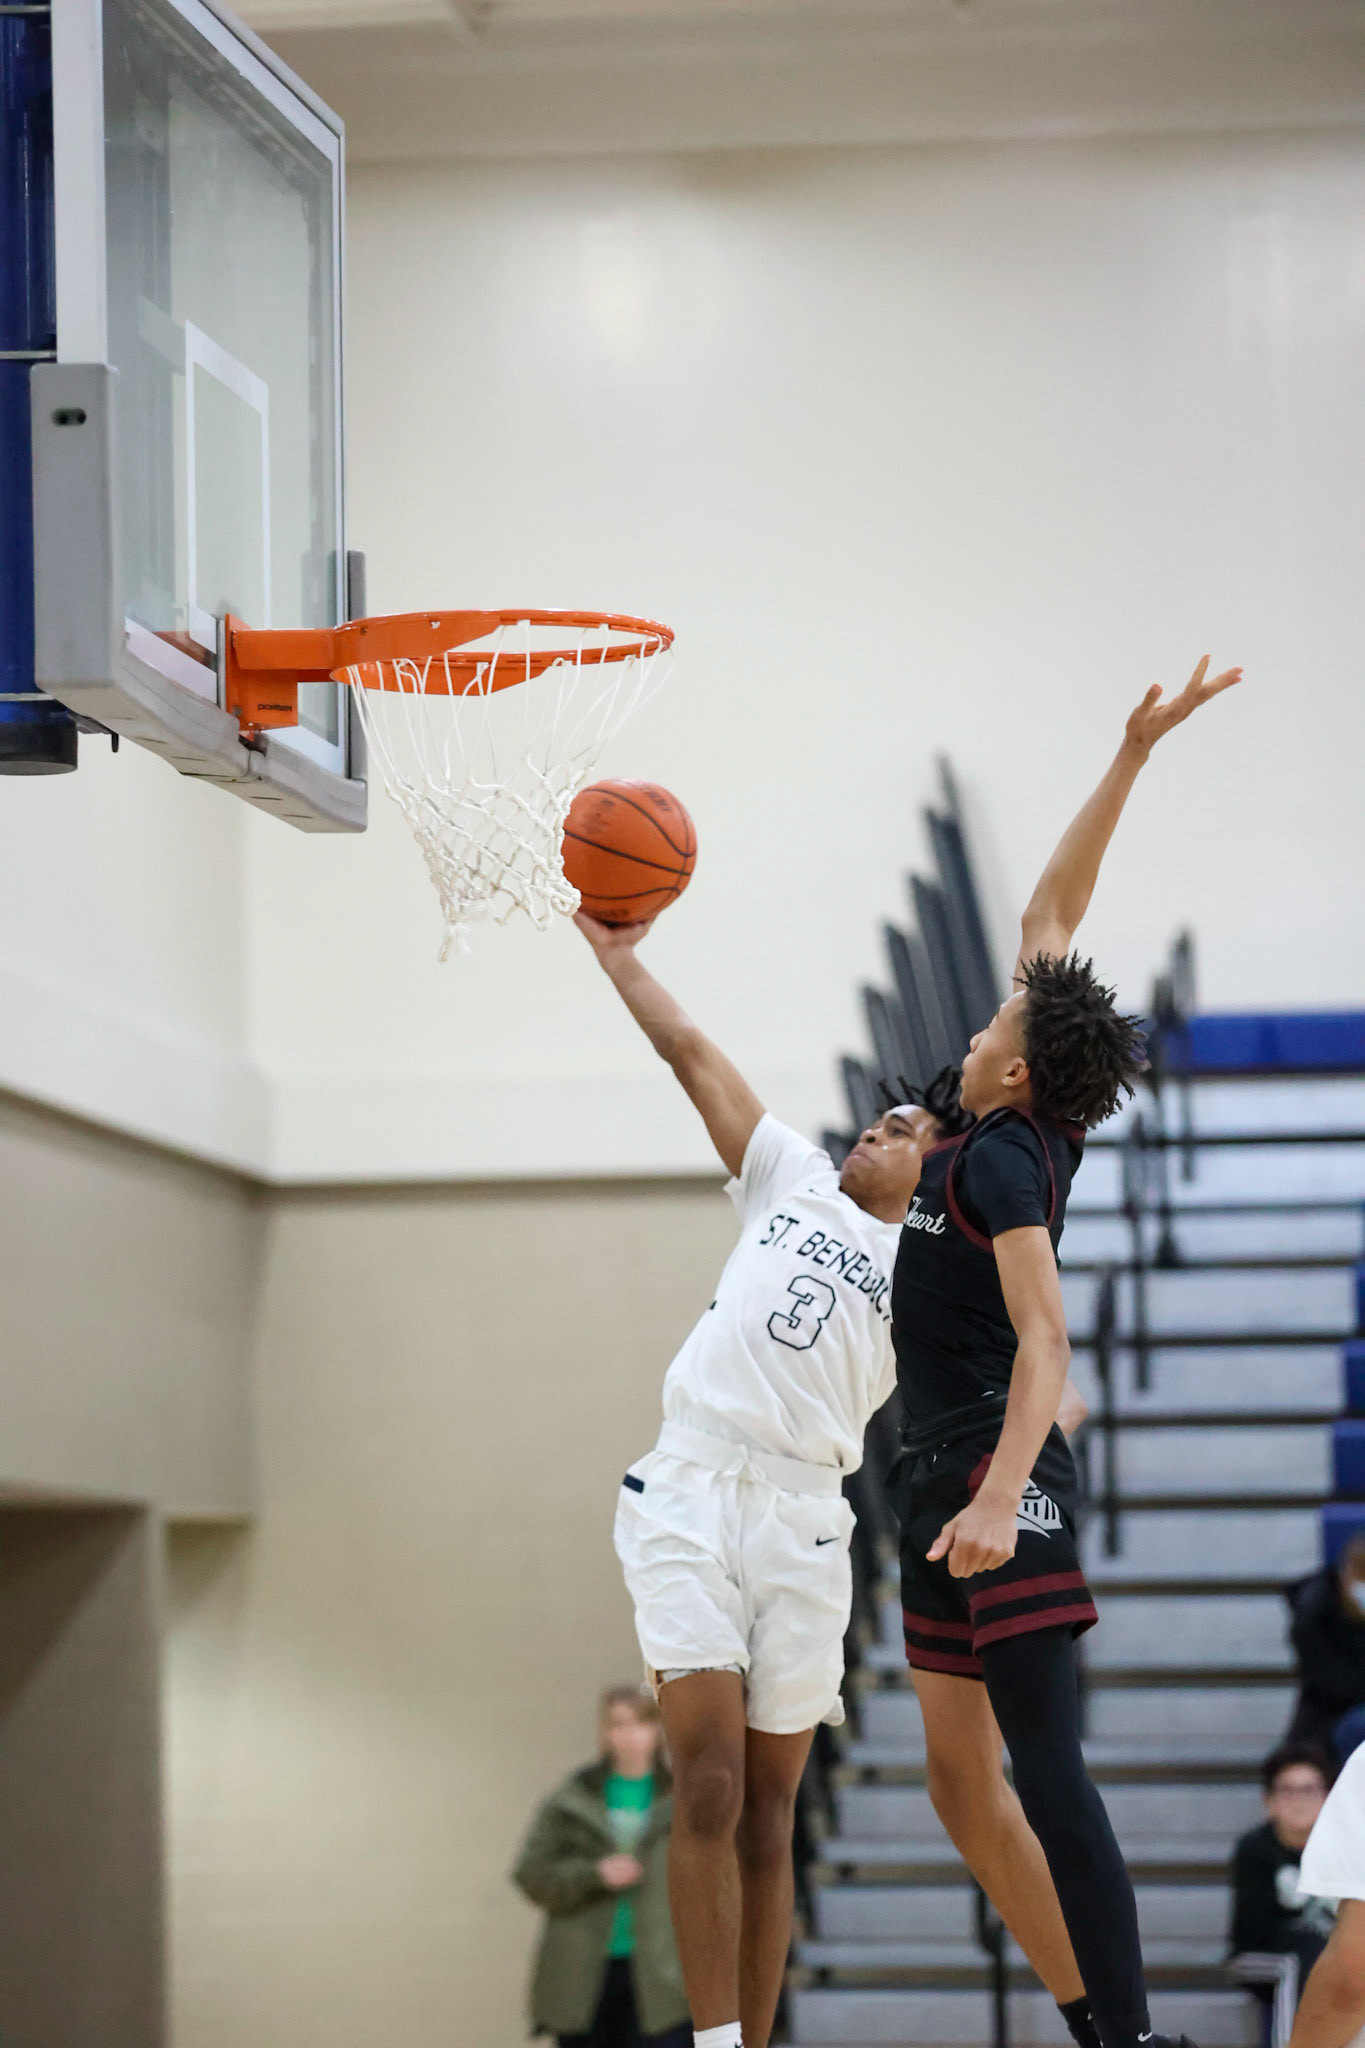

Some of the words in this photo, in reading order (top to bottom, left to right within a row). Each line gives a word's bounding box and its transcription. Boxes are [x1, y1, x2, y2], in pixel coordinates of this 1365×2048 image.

[759, 1213, 800, 1249] ST.
[796, 1230, 890, 1322] BENEDIC
[766, 1274, 837, 1351] 3
